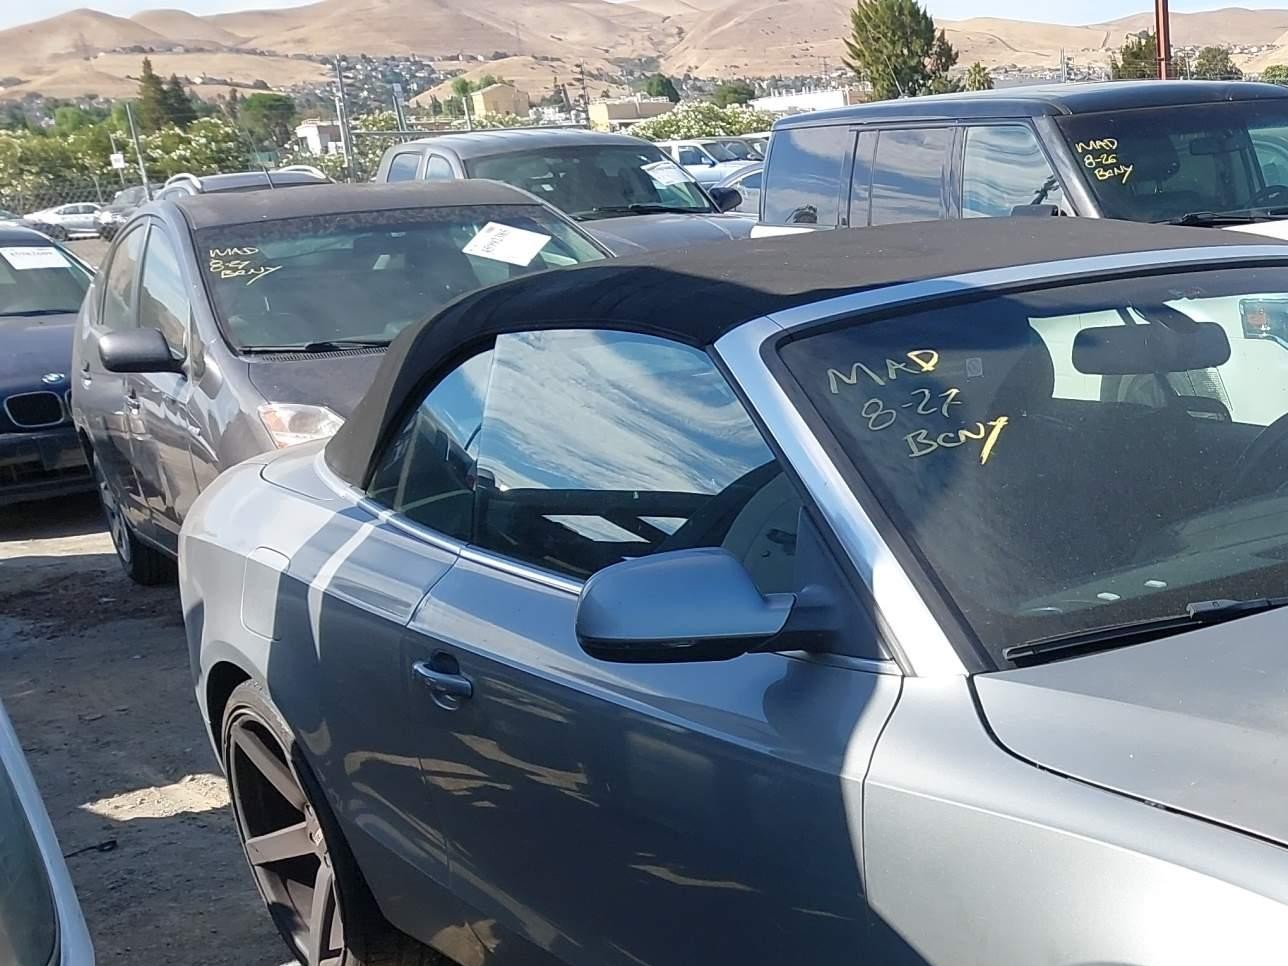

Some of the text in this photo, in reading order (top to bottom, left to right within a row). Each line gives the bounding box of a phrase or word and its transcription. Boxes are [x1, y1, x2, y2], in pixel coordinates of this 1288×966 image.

[1074, 138, 1118, 153] MAD
[1083, 153, 1118, 168] 8-26
[208, 247, 260, 258] MAD
[826, 349, 940, 394] MAD
[860, 387, 964, 431] 8-27
